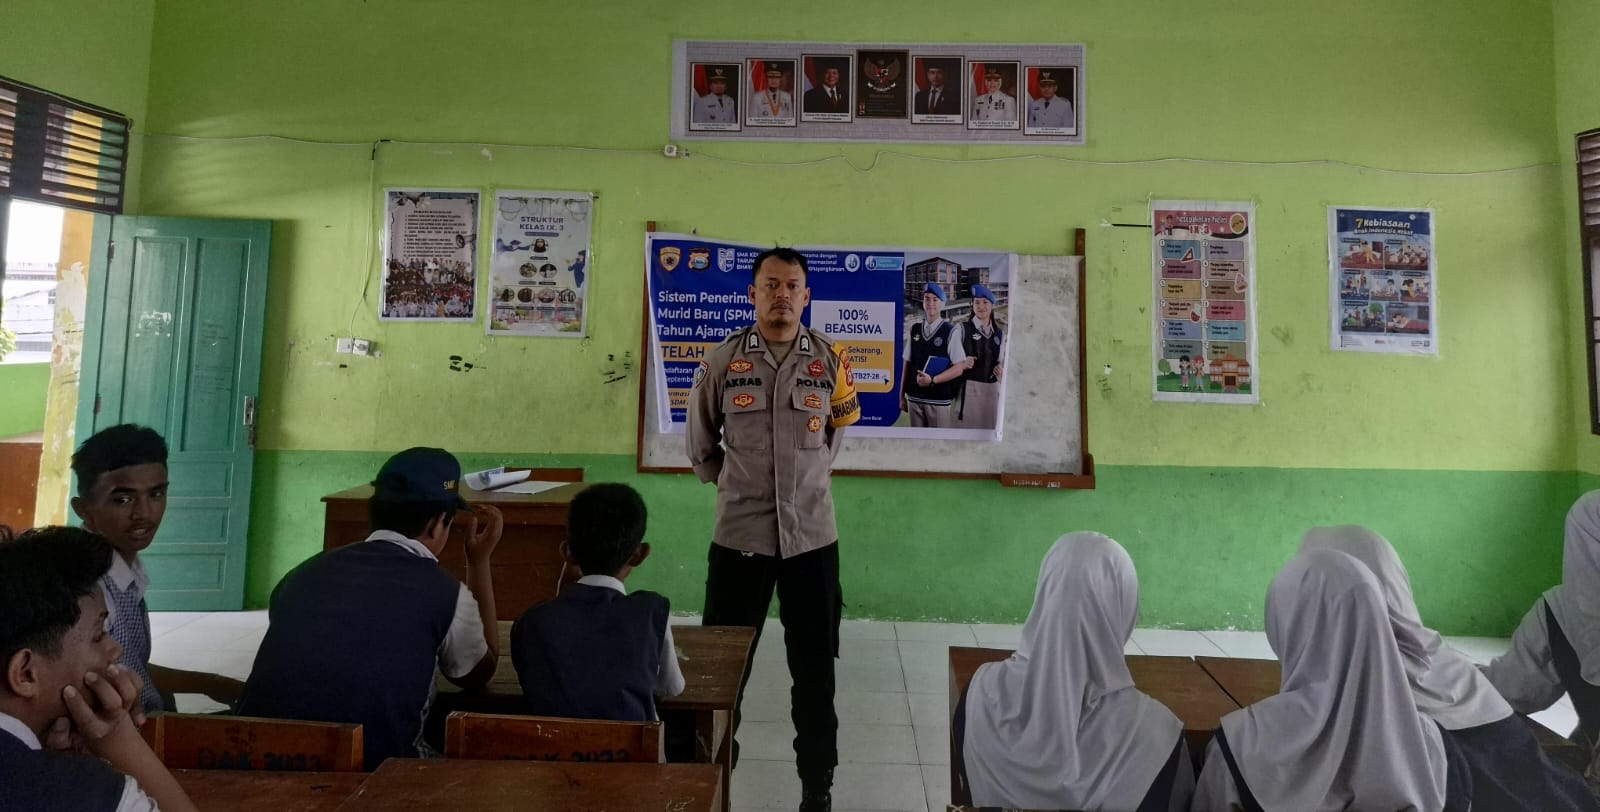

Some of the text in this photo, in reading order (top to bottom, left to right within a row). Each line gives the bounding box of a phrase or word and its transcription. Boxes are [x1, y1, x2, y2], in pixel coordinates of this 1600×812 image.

[1355, 218, 1410, 228] 7 Kebiasaan
[658, 291, 697, 302] Sistem
[657, 307, 691, 319] Murid
[694, 309, 721, 320] Baru
[838, 309, 868, 320] 100%
[656, 325, 692, 336] Tahun
[695, 325, 732, 339] Ajaran
[825, 323, 882, 334] BEASISWA
[661, 345, 705, 358] TELAH
[848, 346, 883, 355] Sekarang,
[667, 375, 695, 384] eptembe
[725, 377, 762, 388] AKRAB
